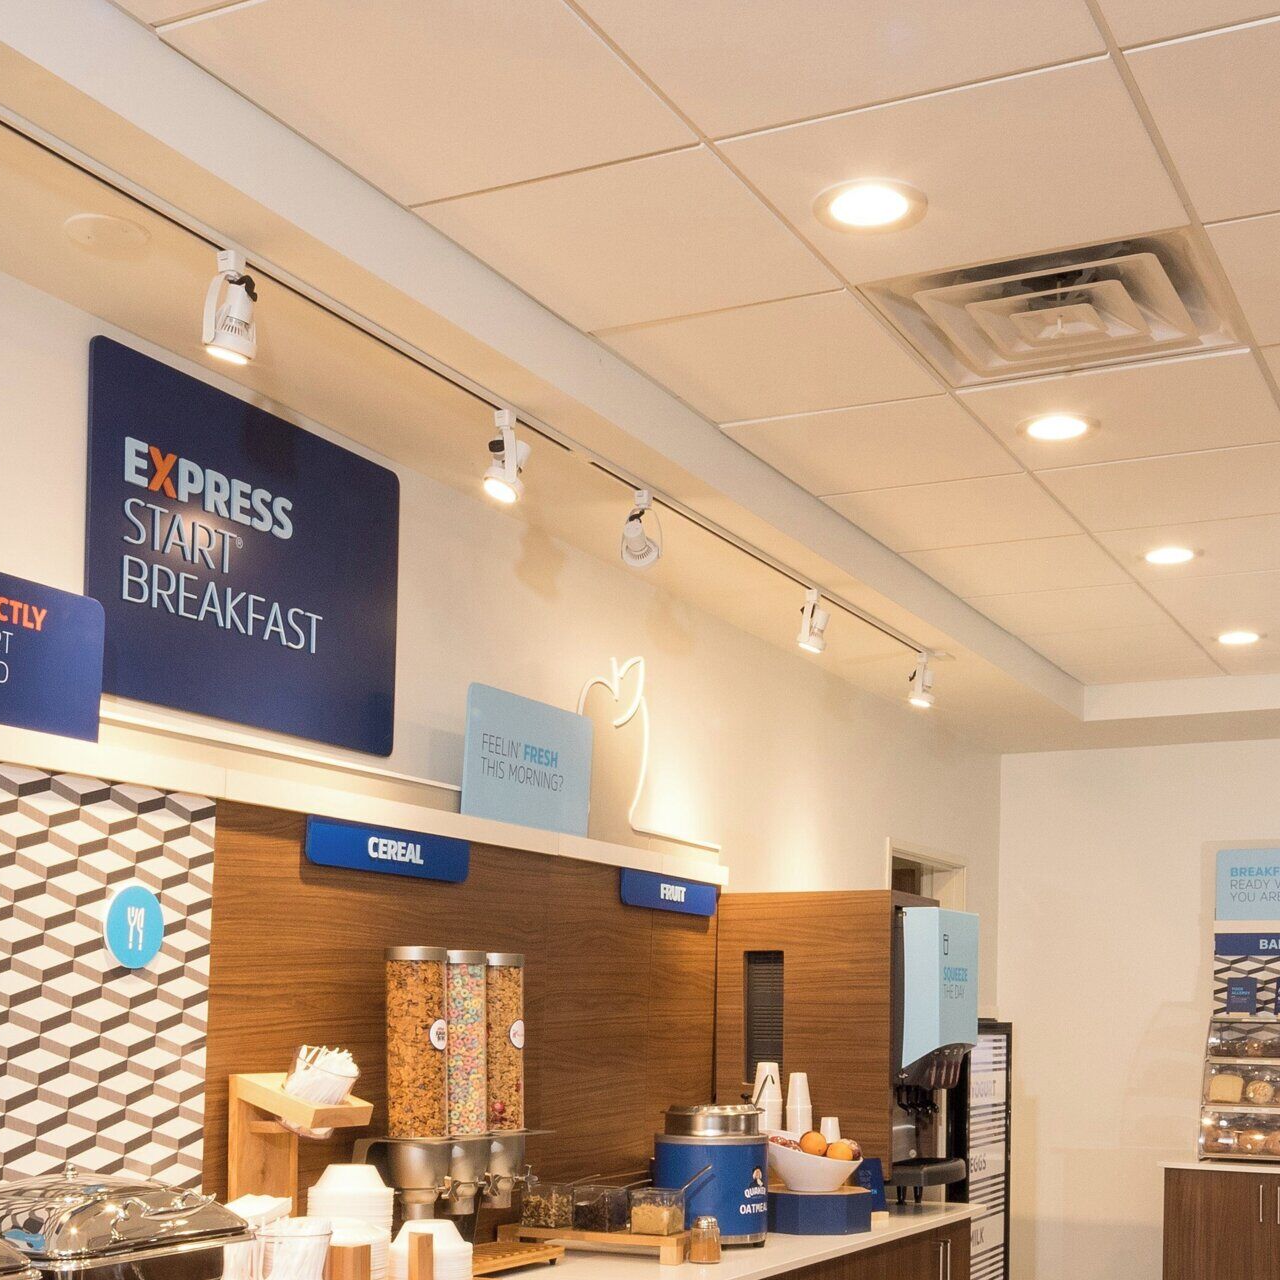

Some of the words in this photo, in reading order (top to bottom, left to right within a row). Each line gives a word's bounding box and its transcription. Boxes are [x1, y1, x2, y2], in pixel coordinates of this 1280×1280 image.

[124, 436, 294, 540] EXPRESS
[121, 554, 323, 655] BREAKFAST
[523, 744, 559, 769] FRESH
[480, 756, 505, 780] THIS
[508, 764, 564, 793] MORNING?
[367, 836, 424, 865] CEREAL
[660, 883, 687, 903] FRUIT
[1230, 879, 1271, 890] READY
[1230, 891, 1256, 902] YOU
